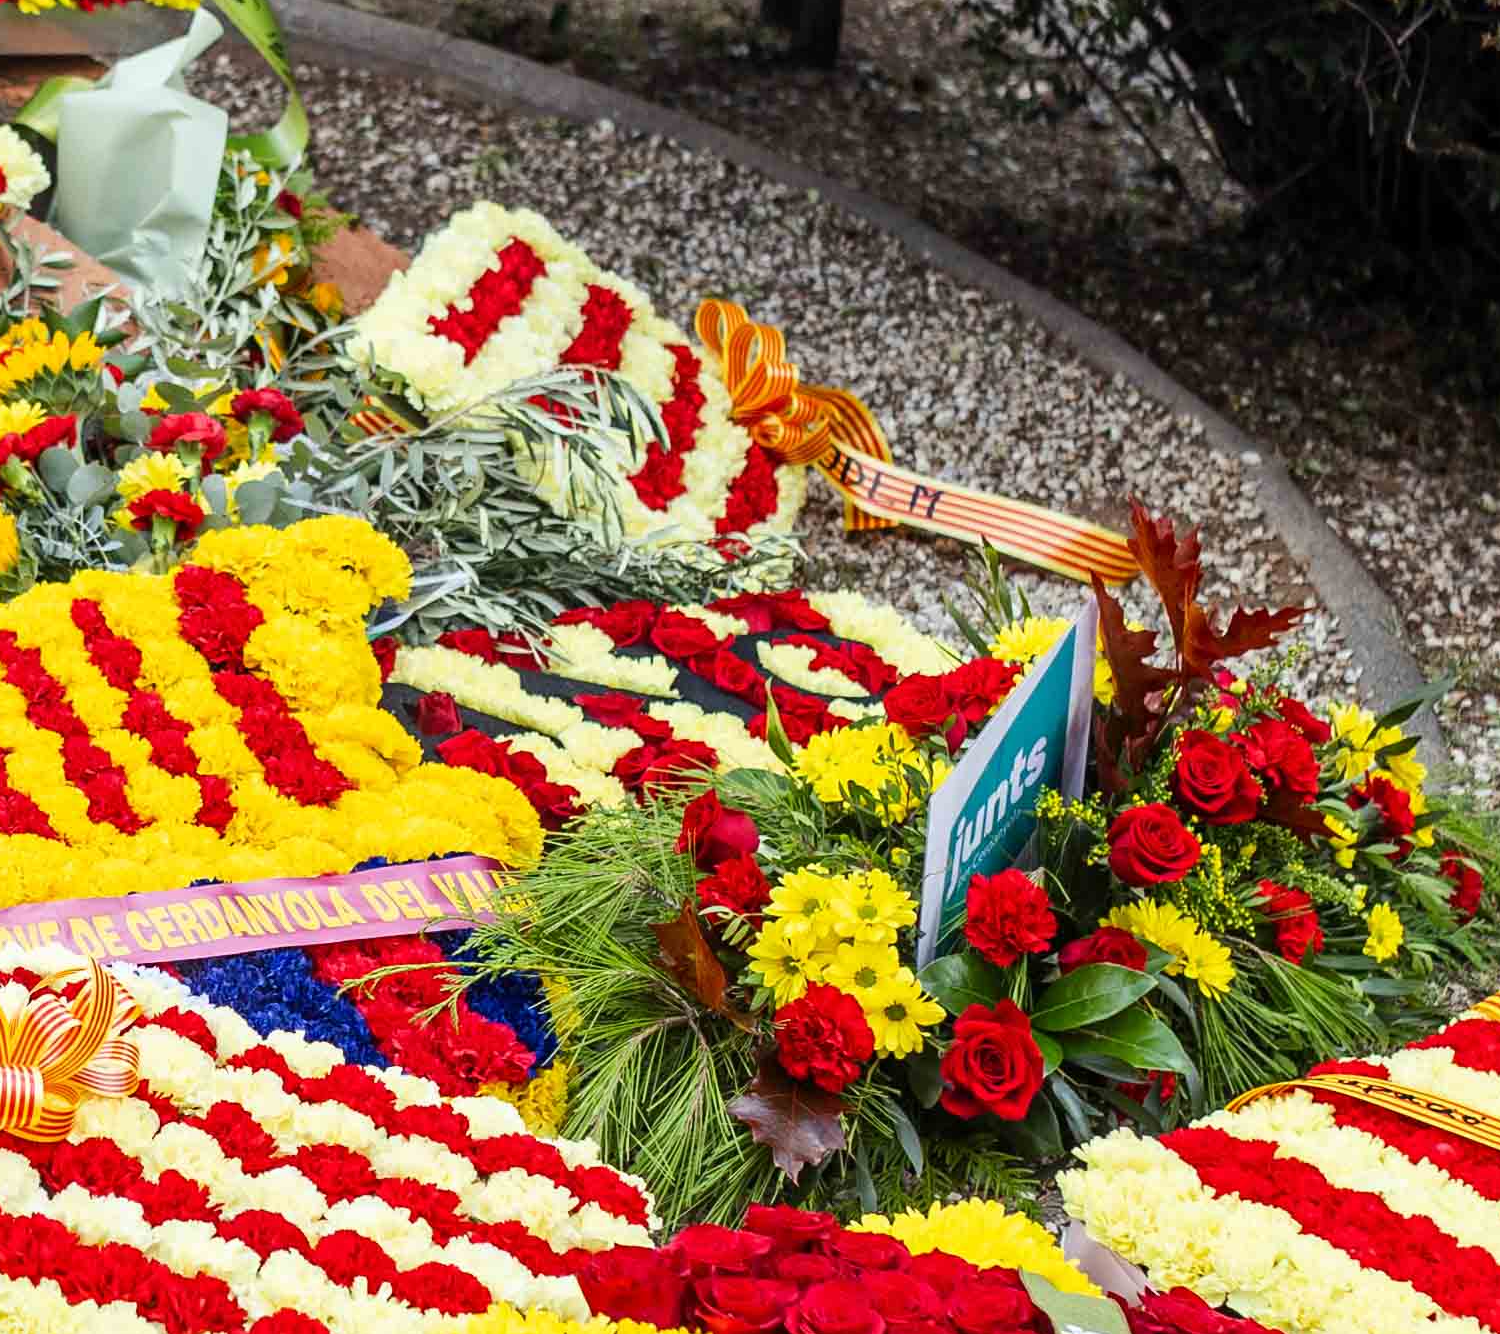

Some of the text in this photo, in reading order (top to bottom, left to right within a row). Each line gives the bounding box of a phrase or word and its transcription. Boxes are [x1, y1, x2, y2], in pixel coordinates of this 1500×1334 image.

[946, 733, 1049, 902] junts
[71, 914, 132, 963] DE
[127, 883, 369, 954] CERDANYOLA
[358, 877, 445, 924] DEL
